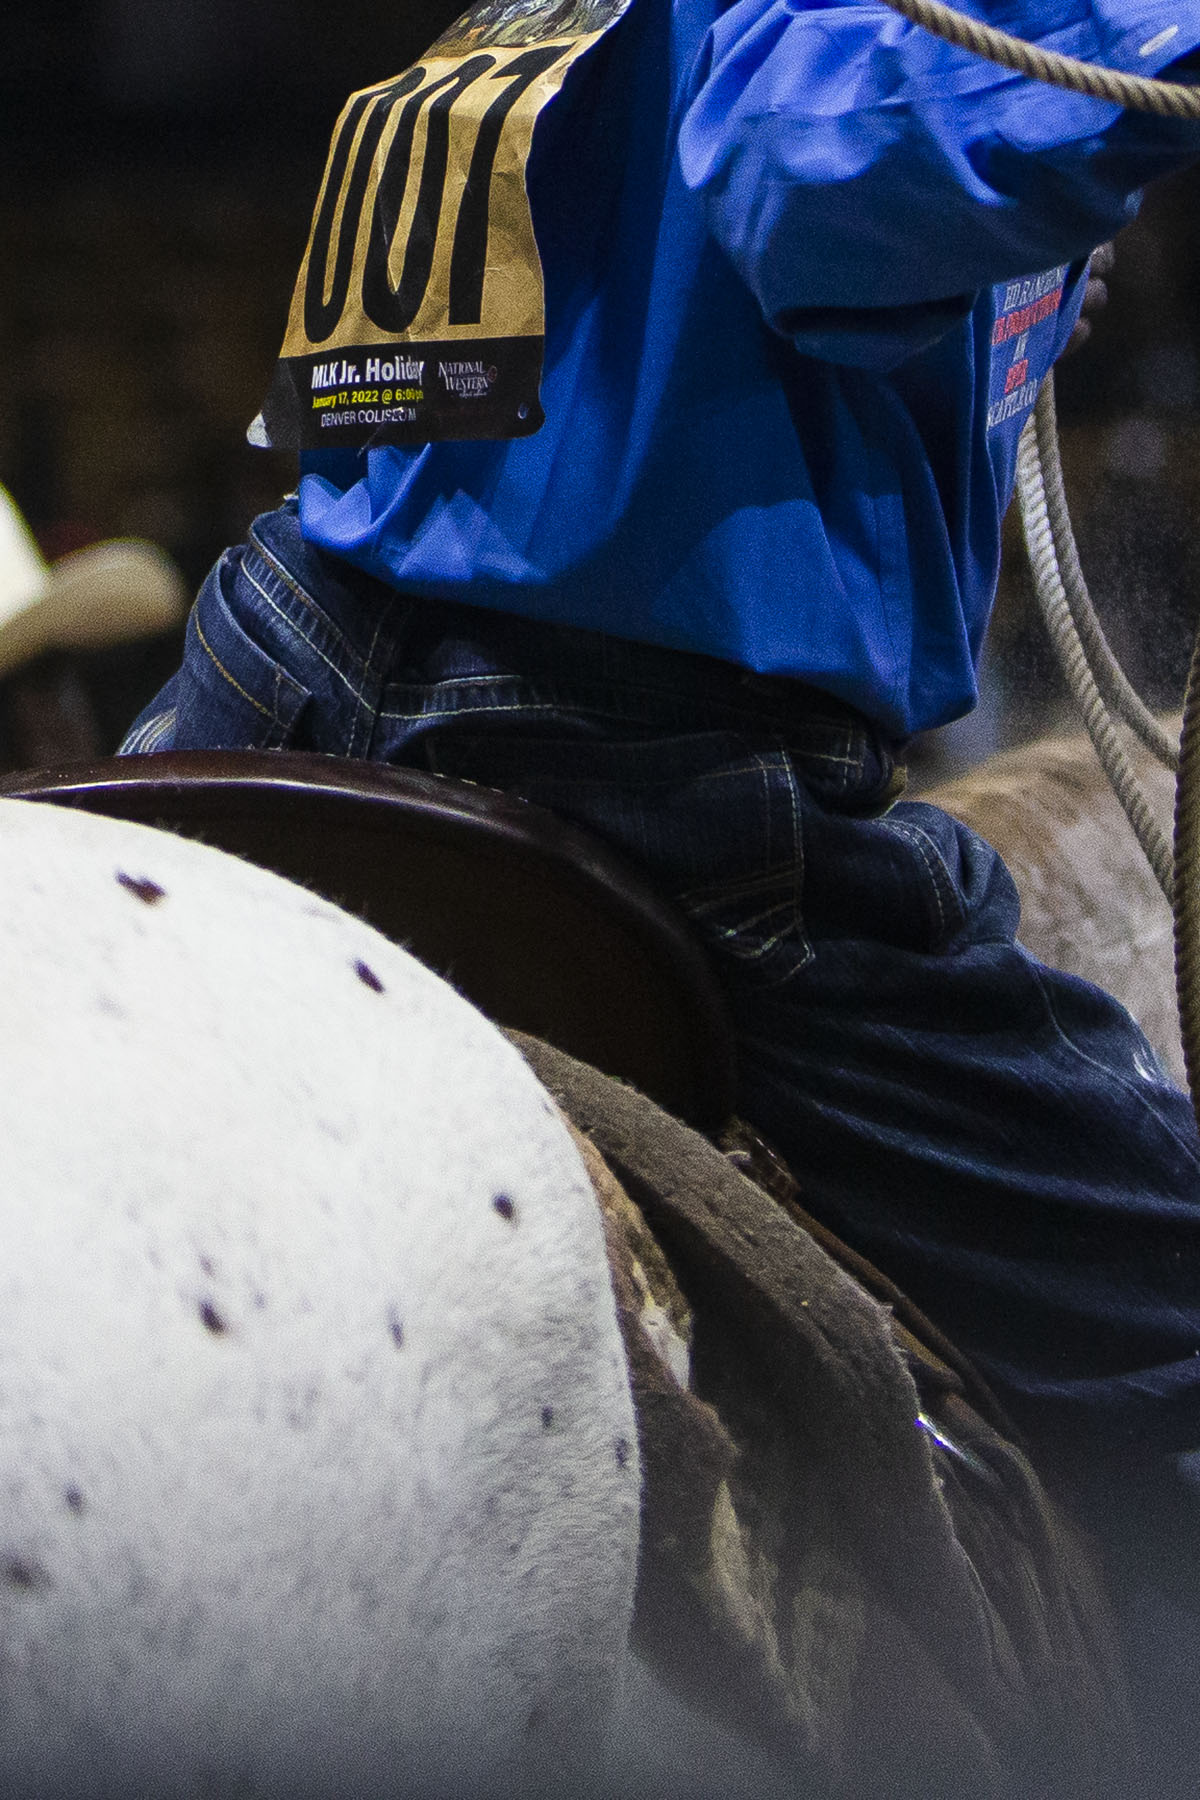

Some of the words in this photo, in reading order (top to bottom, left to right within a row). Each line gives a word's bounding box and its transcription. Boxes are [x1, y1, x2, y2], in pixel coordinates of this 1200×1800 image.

[311, 361, 339, 390] MLK
[339, 360, 361, 384] Jr.
[447, 376, 489, 391] WESTERN
[338, 391, 349, 405] 17,
[351, 389, 379, 404] 2022
[381, 388, 393, 405] @
[321, 410, 356, 428] DENVER
